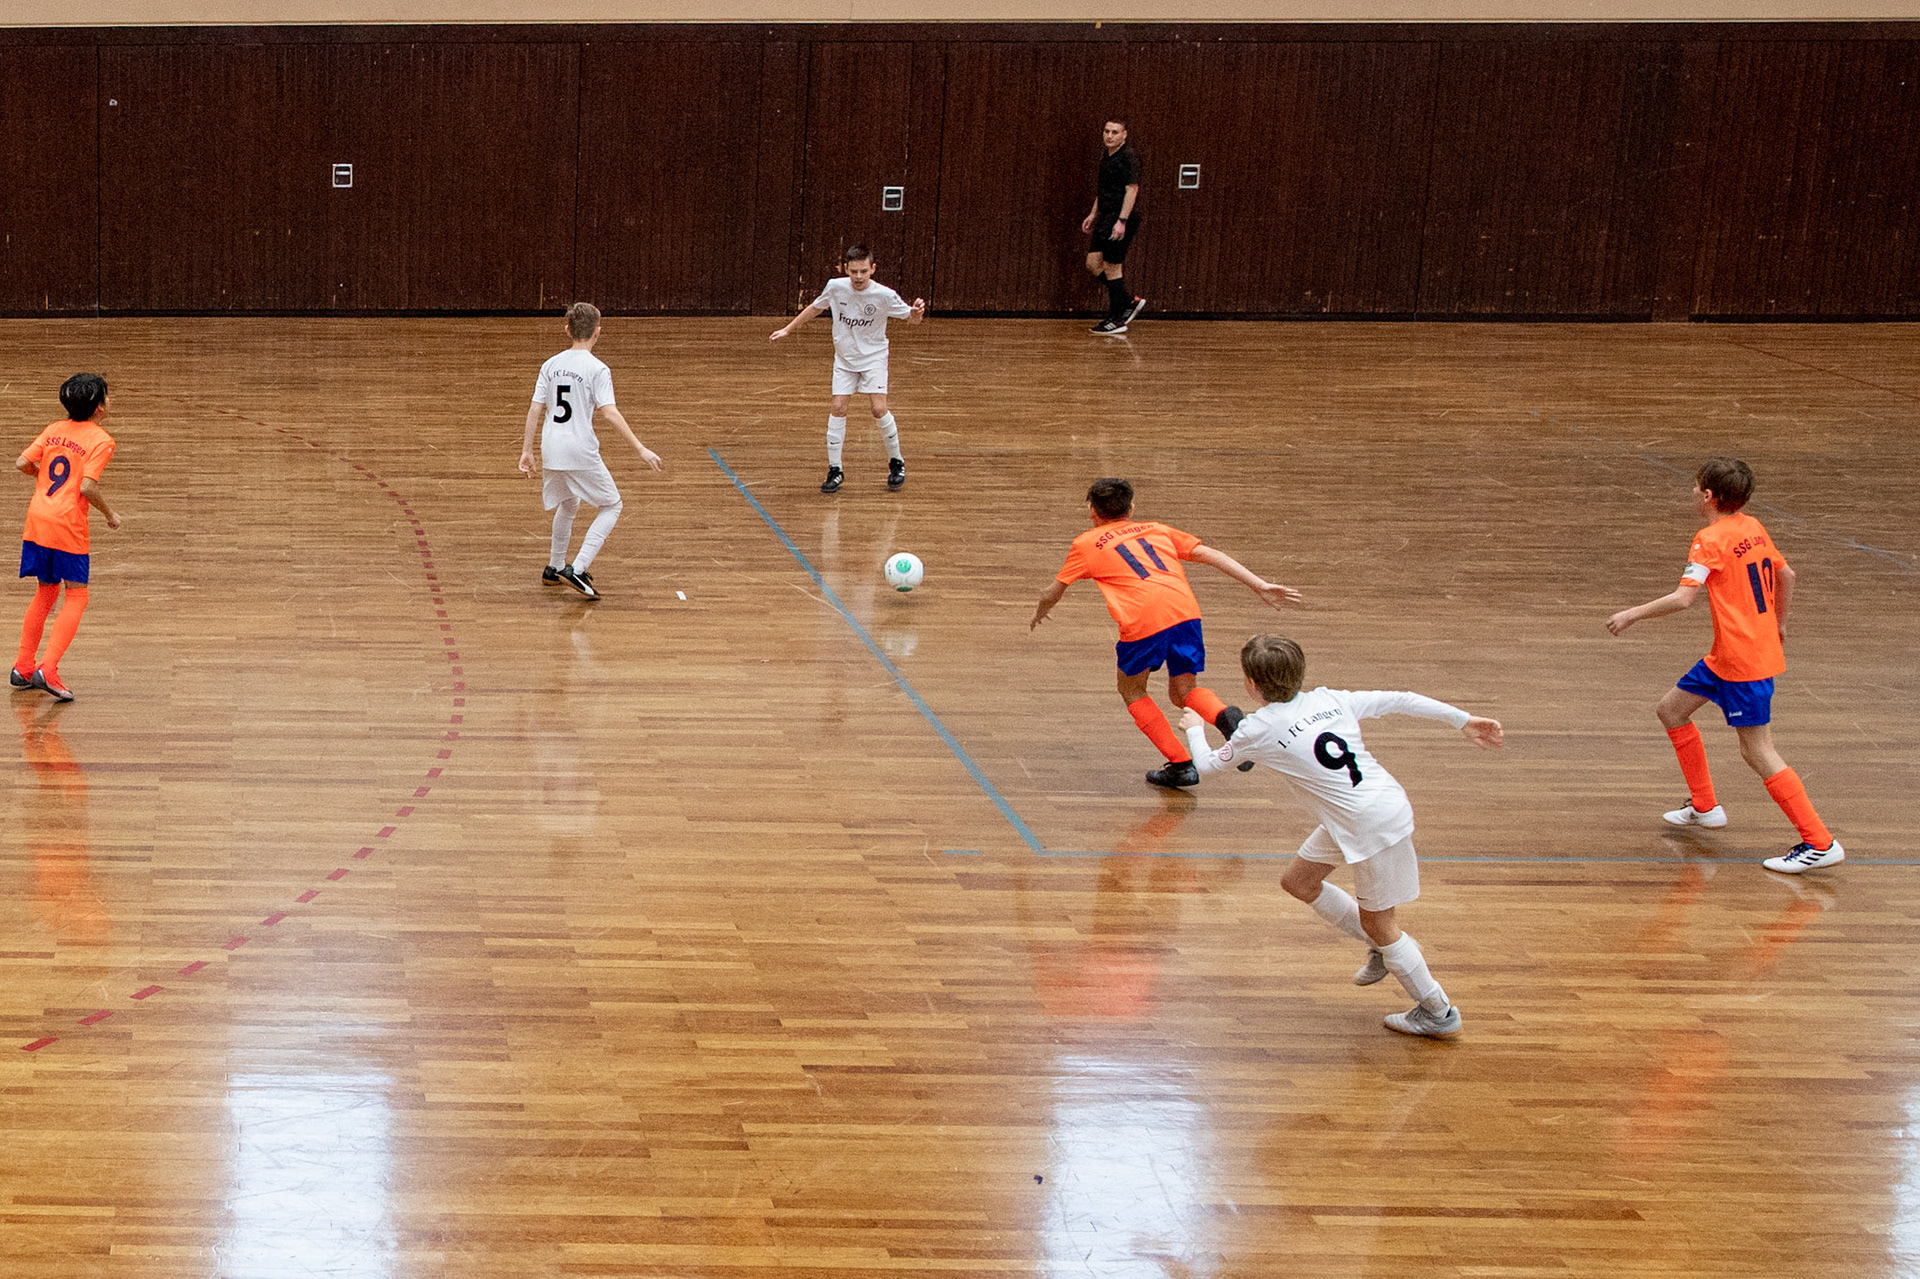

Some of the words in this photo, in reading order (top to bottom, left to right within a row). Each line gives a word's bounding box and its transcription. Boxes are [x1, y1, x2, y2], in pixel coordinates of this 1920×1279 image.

[553, 384, 572, 424] 5
[45, 437, 61, 447] SSG
[61, 437, 86, 457] Langen
[46, 454, 71, 496] 9
[1095, 531, 1114, 550] SSG
[1114, 524, 1154, 536] Langen
[1733, 539, 1752, 558] SSG
[1114, 537, 1169, 580] 11
[1746, 557, 1774, 614] 10
[1288, 722, 1305, 738] FC
[1303, 707, 1343, 726] Langen
[1313, 731, 1364, 788] 9
